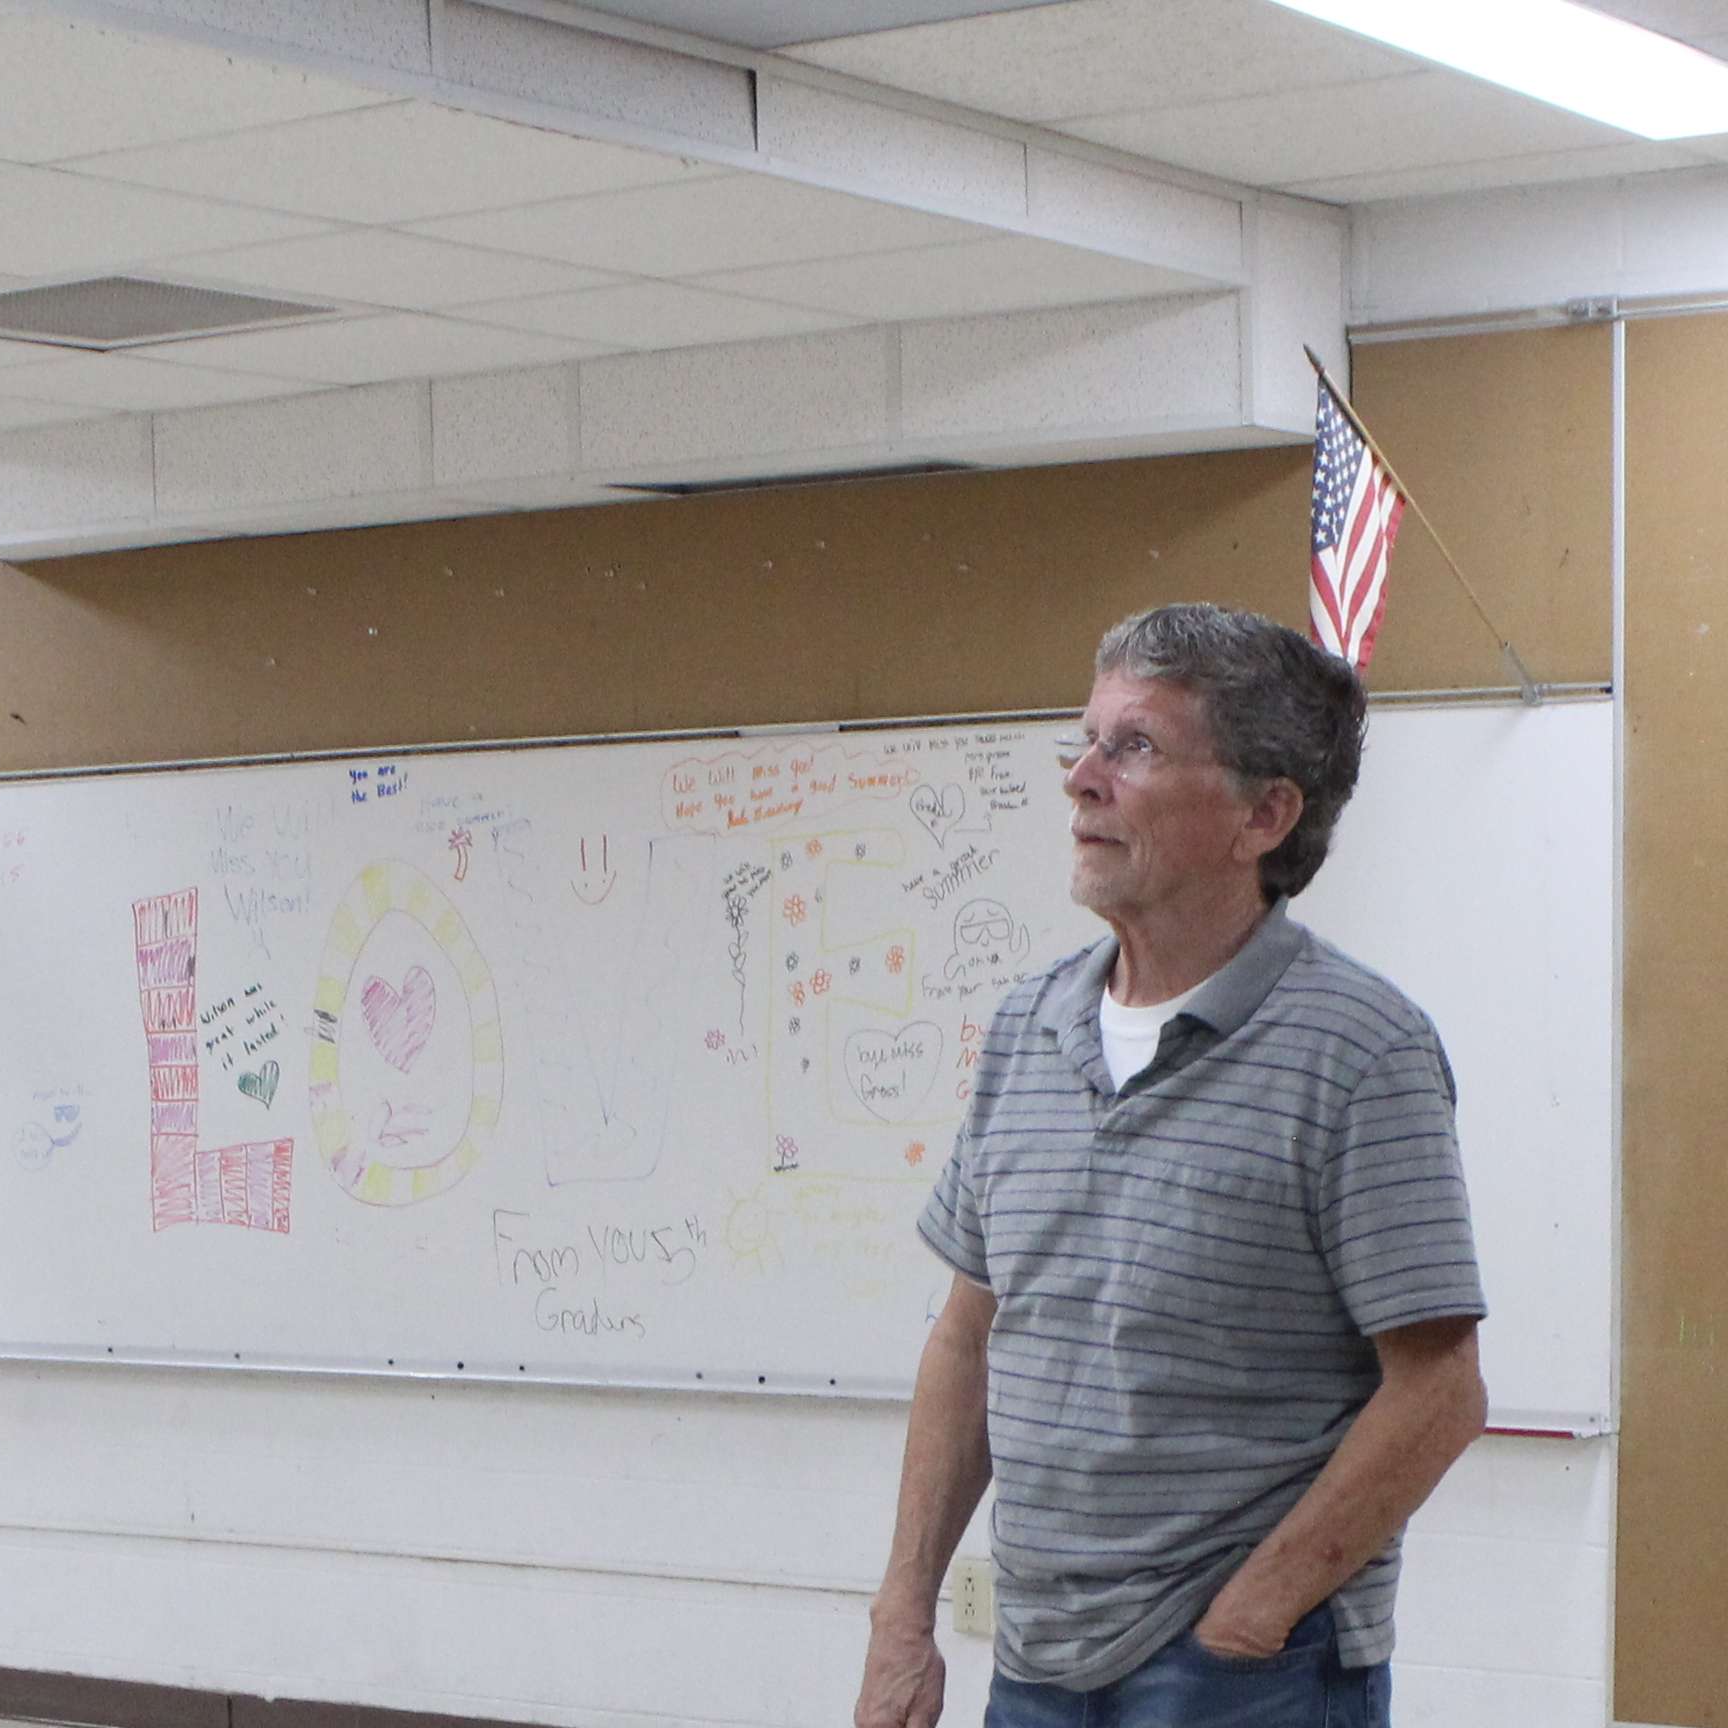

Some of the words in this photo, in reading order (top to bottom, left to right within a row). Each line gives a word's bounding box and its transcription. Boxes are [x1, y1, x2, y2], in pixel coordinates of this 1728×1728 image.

[377, 765, 397, 777] are
[200, 997, 236, 1025] Wilson
[205, 1025, 235, 1055] great
[246, 1000, 278, 1025] while
[221, 1052, 234, 1071] it
